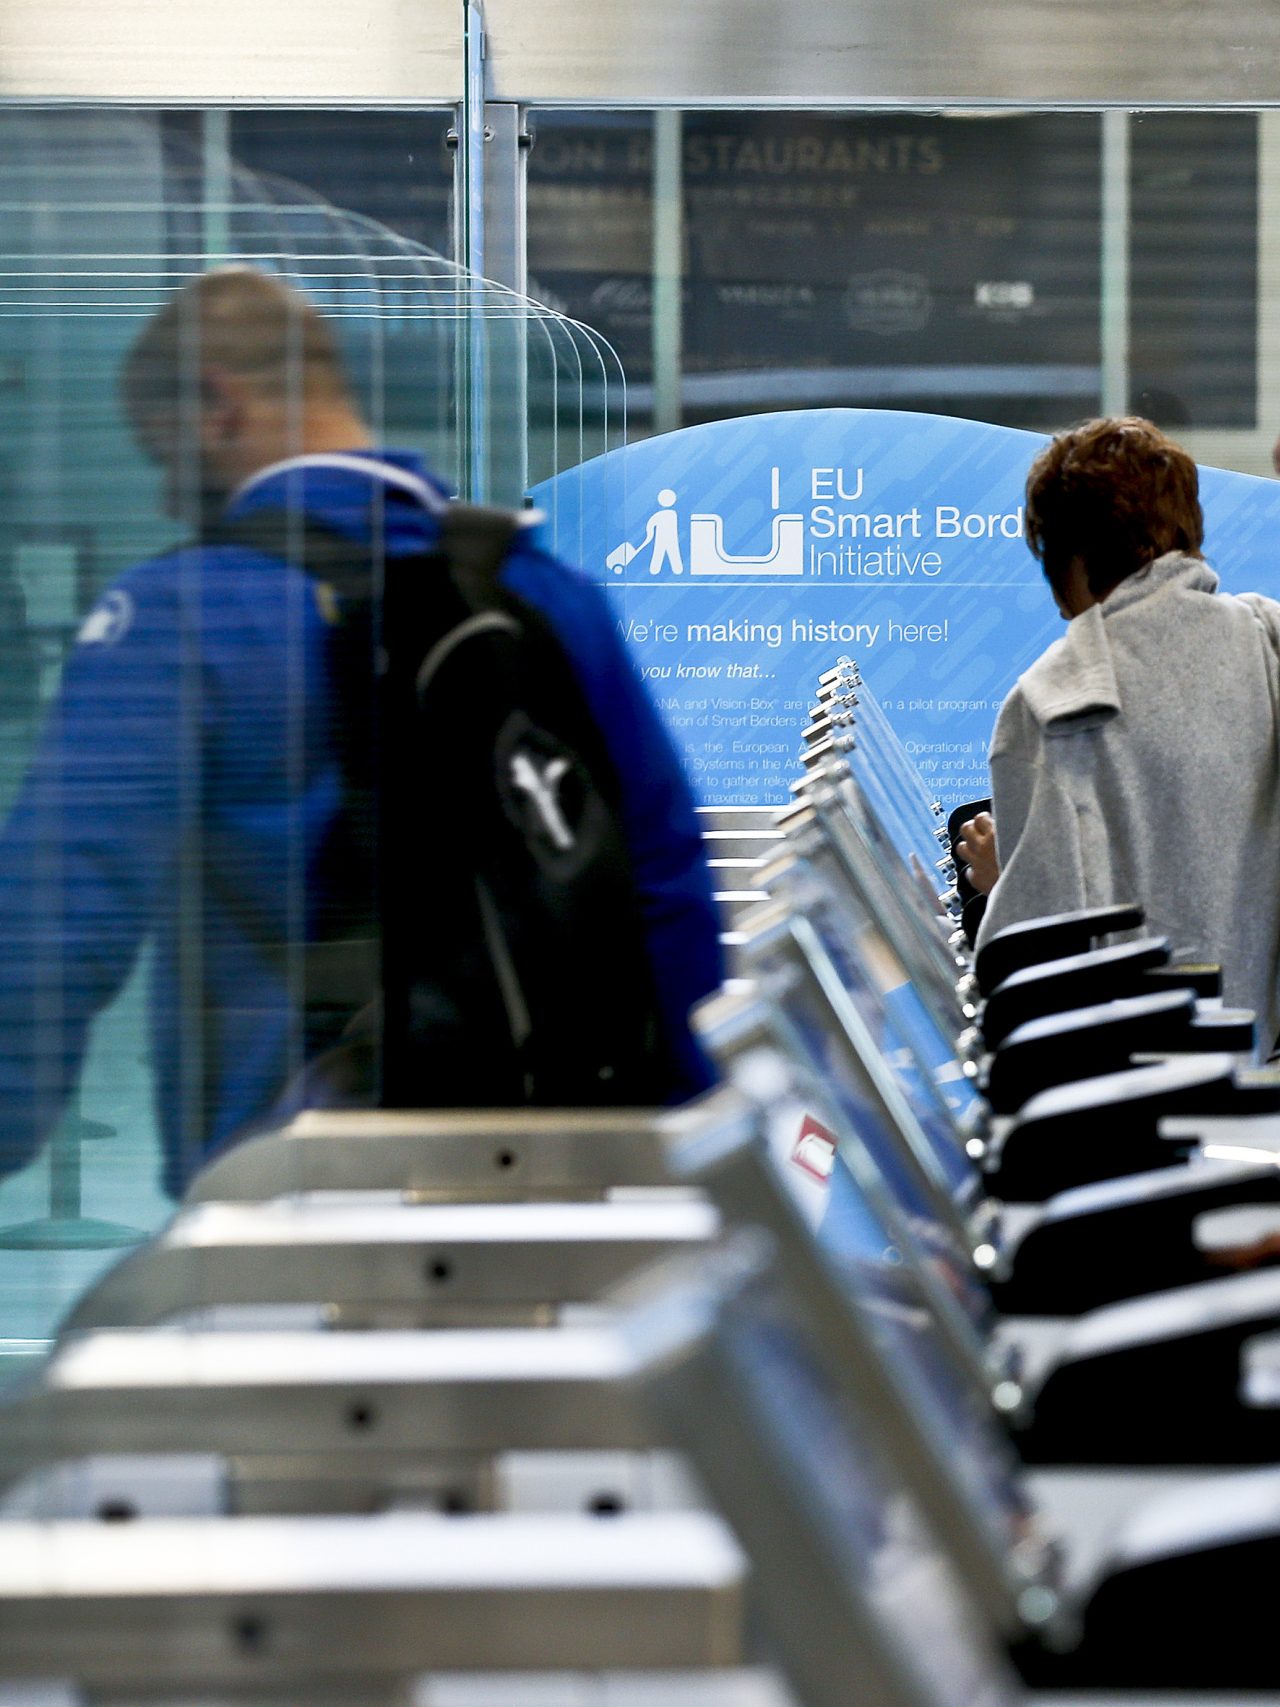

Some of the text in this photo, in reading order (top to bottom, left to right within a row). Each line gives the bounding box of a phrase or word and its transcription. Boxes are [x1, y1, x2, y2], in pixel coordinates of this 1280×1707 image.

[628, 136, 944, 175] RSTAURANTS
[811, 468, 864, 501] EU
[810, 506, 1023, 539] Smart Bord
[809, 544, 943, 577] Initiative
[686, 619, 783, 648] making
[791, 619, 880, 648] history
[887, 619, 949, 642] here!
[640, 666, 671, 682] you
[675, 663, 721, 679] know
[684, 698, 707, 710] and
[784, 701, 803, 710] are
[897, 702, 905, 710] a
[909, 698, 934, 712] pilot
[938, 701, 988, 713] program
[696, 715, 709, 727] of
[713, 715, 747, 727] Smart
[750, 715, 797, 727] Borders
[685, 742, 695, 753] is
[704, 742, 723, 753] the
[732, 742, 789, 755] European
[905, 741, 973, 755] Operational
[693, 758, 745, 773] Systems
[748, 758, 759, 770] in
[762, 758, 781, 770] the
[784, 758, 804, 770] Are
[914, 758, 938, 773] urity
[941, 758, 964, 770] and
[707, 775, 719, 787] to
[722, 775, 759, 789] gather
[924, 775, 990, 789] appropriate
[703, 792, 758, 804] maximize
[764, 792, 784, 804] the
